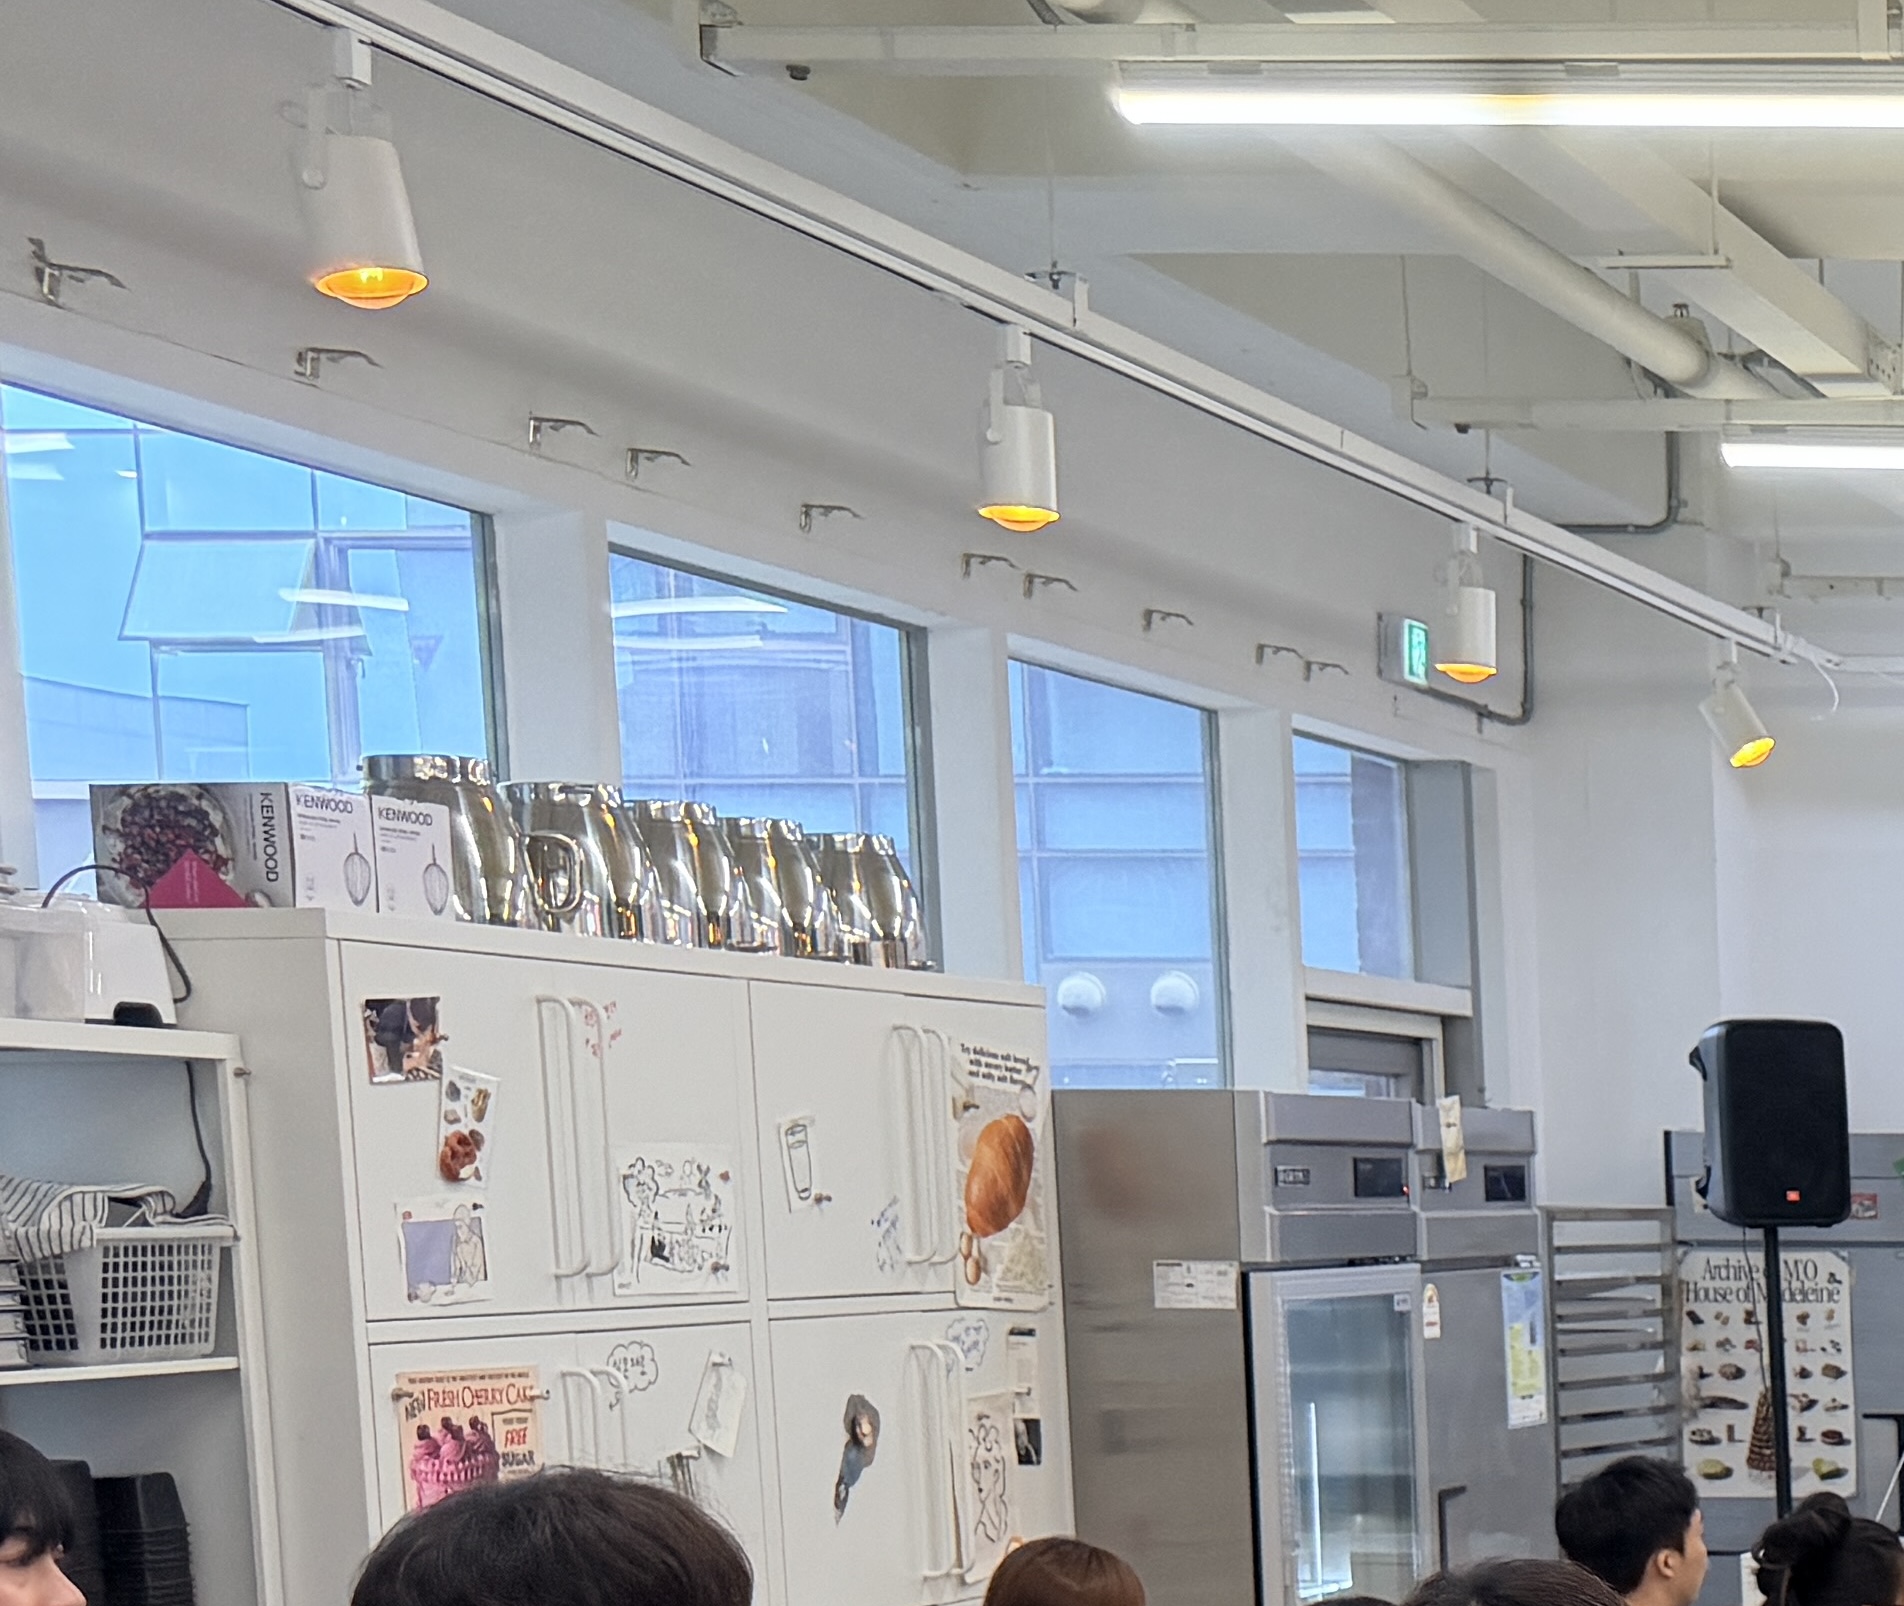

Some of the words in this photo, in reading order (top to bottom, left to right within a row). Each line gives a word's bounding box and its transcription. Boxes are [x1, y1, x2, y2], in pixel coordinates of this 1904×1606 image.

[378, 806, 433, 827] KENWOOD
[260, 792, 279, 882] KENWOOD
[1703, 1257, 1760, 1282] Archive
[1685, 1281, 1733, 1303] House
